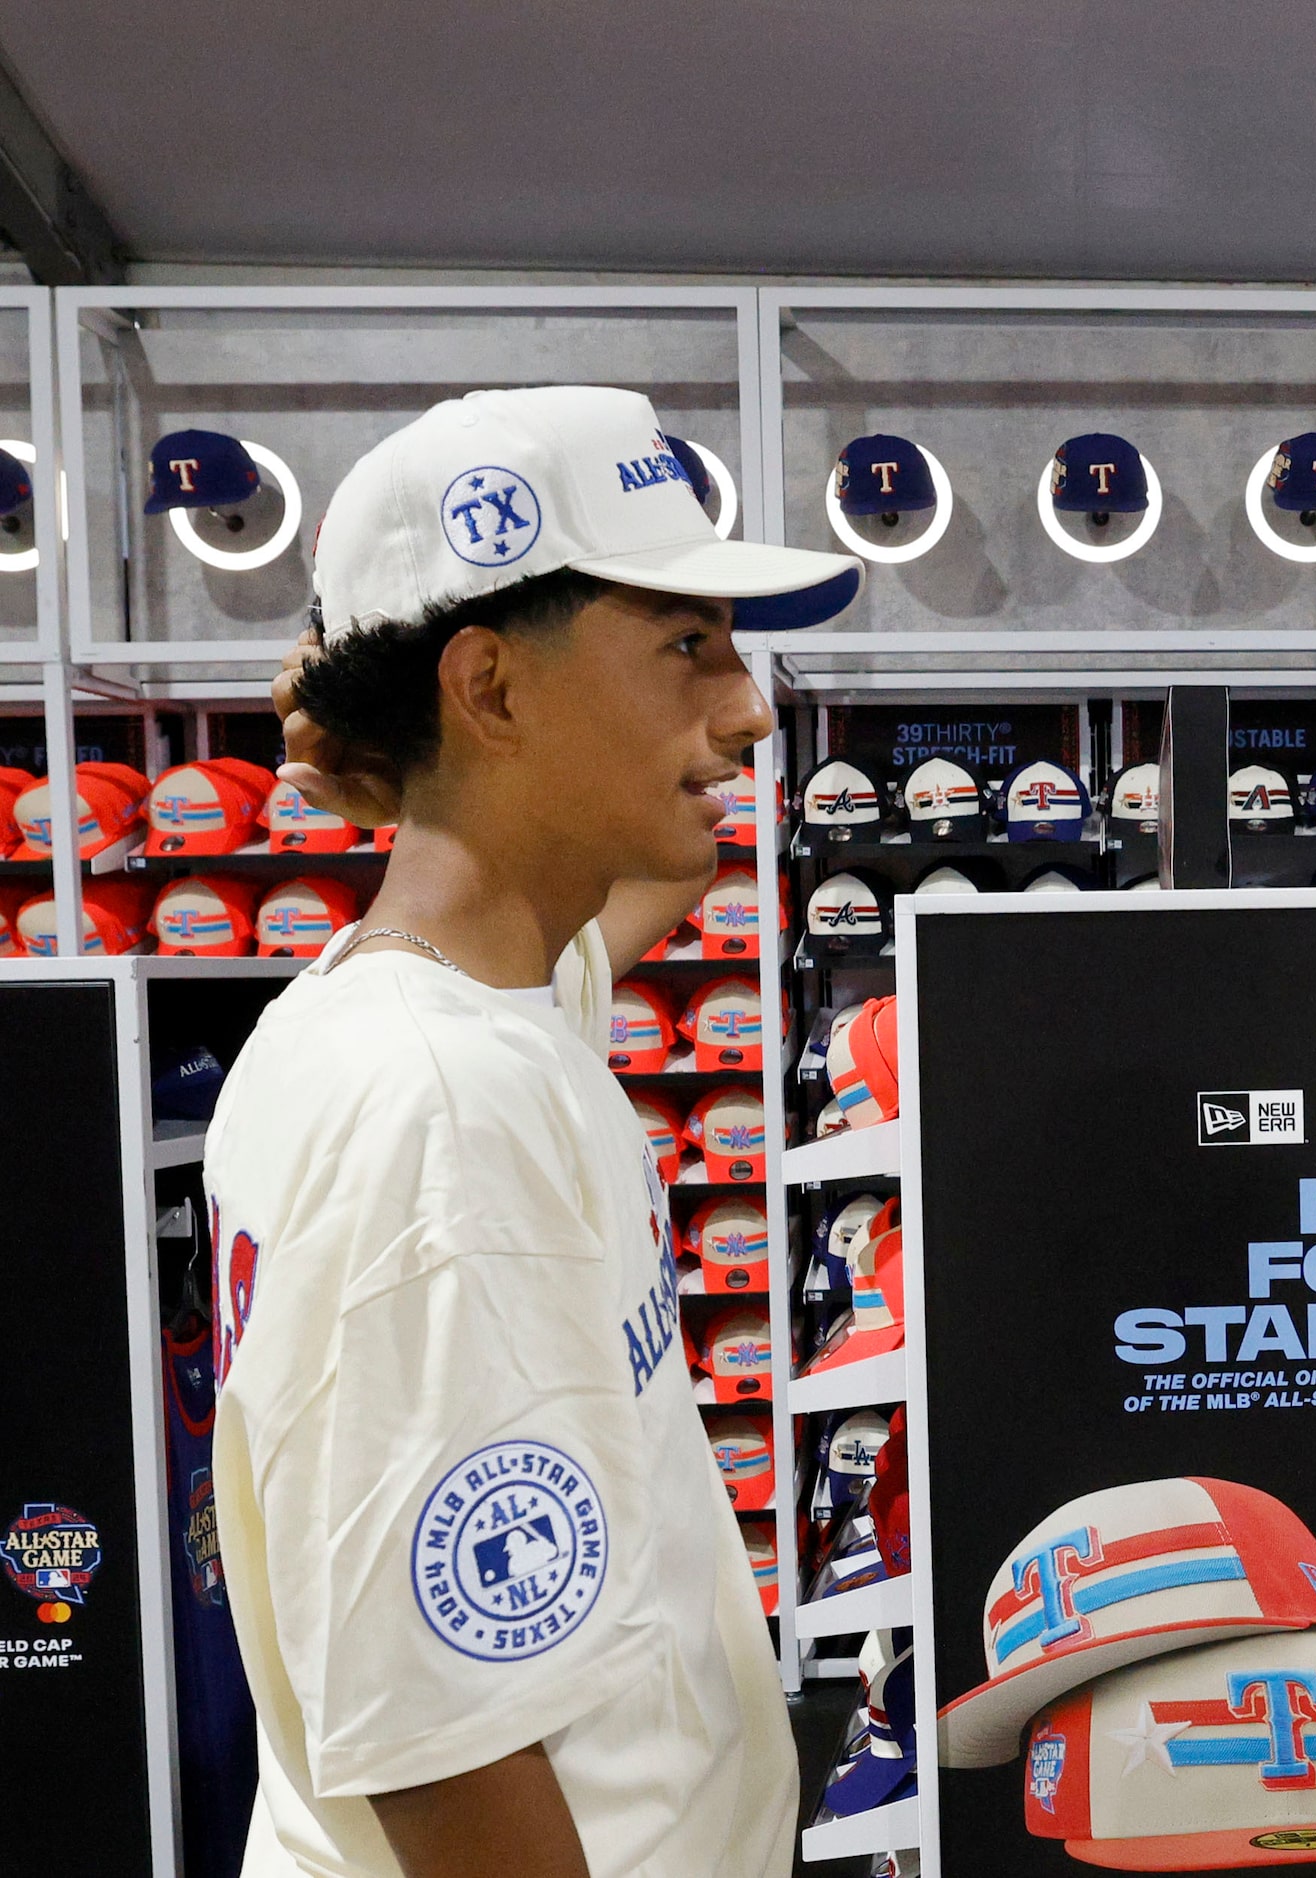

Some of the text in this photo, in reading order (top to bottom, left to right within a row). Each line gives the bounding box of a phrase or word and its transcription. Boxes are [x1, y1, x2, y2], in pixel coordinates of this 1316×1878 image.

[169, 459, 200, 492] T
[871, 462, 900, 496] T
[1089, 463, 1118, 496] T
[451, 485, 531, 545] TX
[164, 795, 191, 826] T
[285, 792, 307, 822] T
[824, 786, 855, 816] A
[1029, 781, 1056, 811] T
[1242, 784, 1272, 811] A
[173, 909, 200, 939] T
[275, 906, 302, 937] T
[828, 900, 857, 928] A
[719, 1009, 746, 1039] T
[1258, 1101, 1296, 1117] NEW
[1258, 1117, 1296, 1133] ERA
[1143, 1373, 1186, 1392] THE
[1191, 1368, 1290, 1389] OFFICIAL
[1123, 1395, 1154, 1413] OF
[1159, 1394, 1201, 1412] THE
[1206, 1391, 1261, 1411] MLB®
[716, 1445, 743, 1474] T
[853, 1439, 871, 1467] LA
[426, 1491, 465, 1550] MLB
[490, 1493, 527, 1530] AL
[574, 1497, 601, 1580] GAME
[22, 1549, 83, 1568] GAME
[424, 1560, 470, 1633] 2024
[506, 1574, 549, 1611] NL
[1012, 1526, 1104, 1655] T
[492, 1603, 576, 1650] TEXAS
[32, 1638, 73, 1652] CAP
[13, 1654, 83, 1669] GAME™
